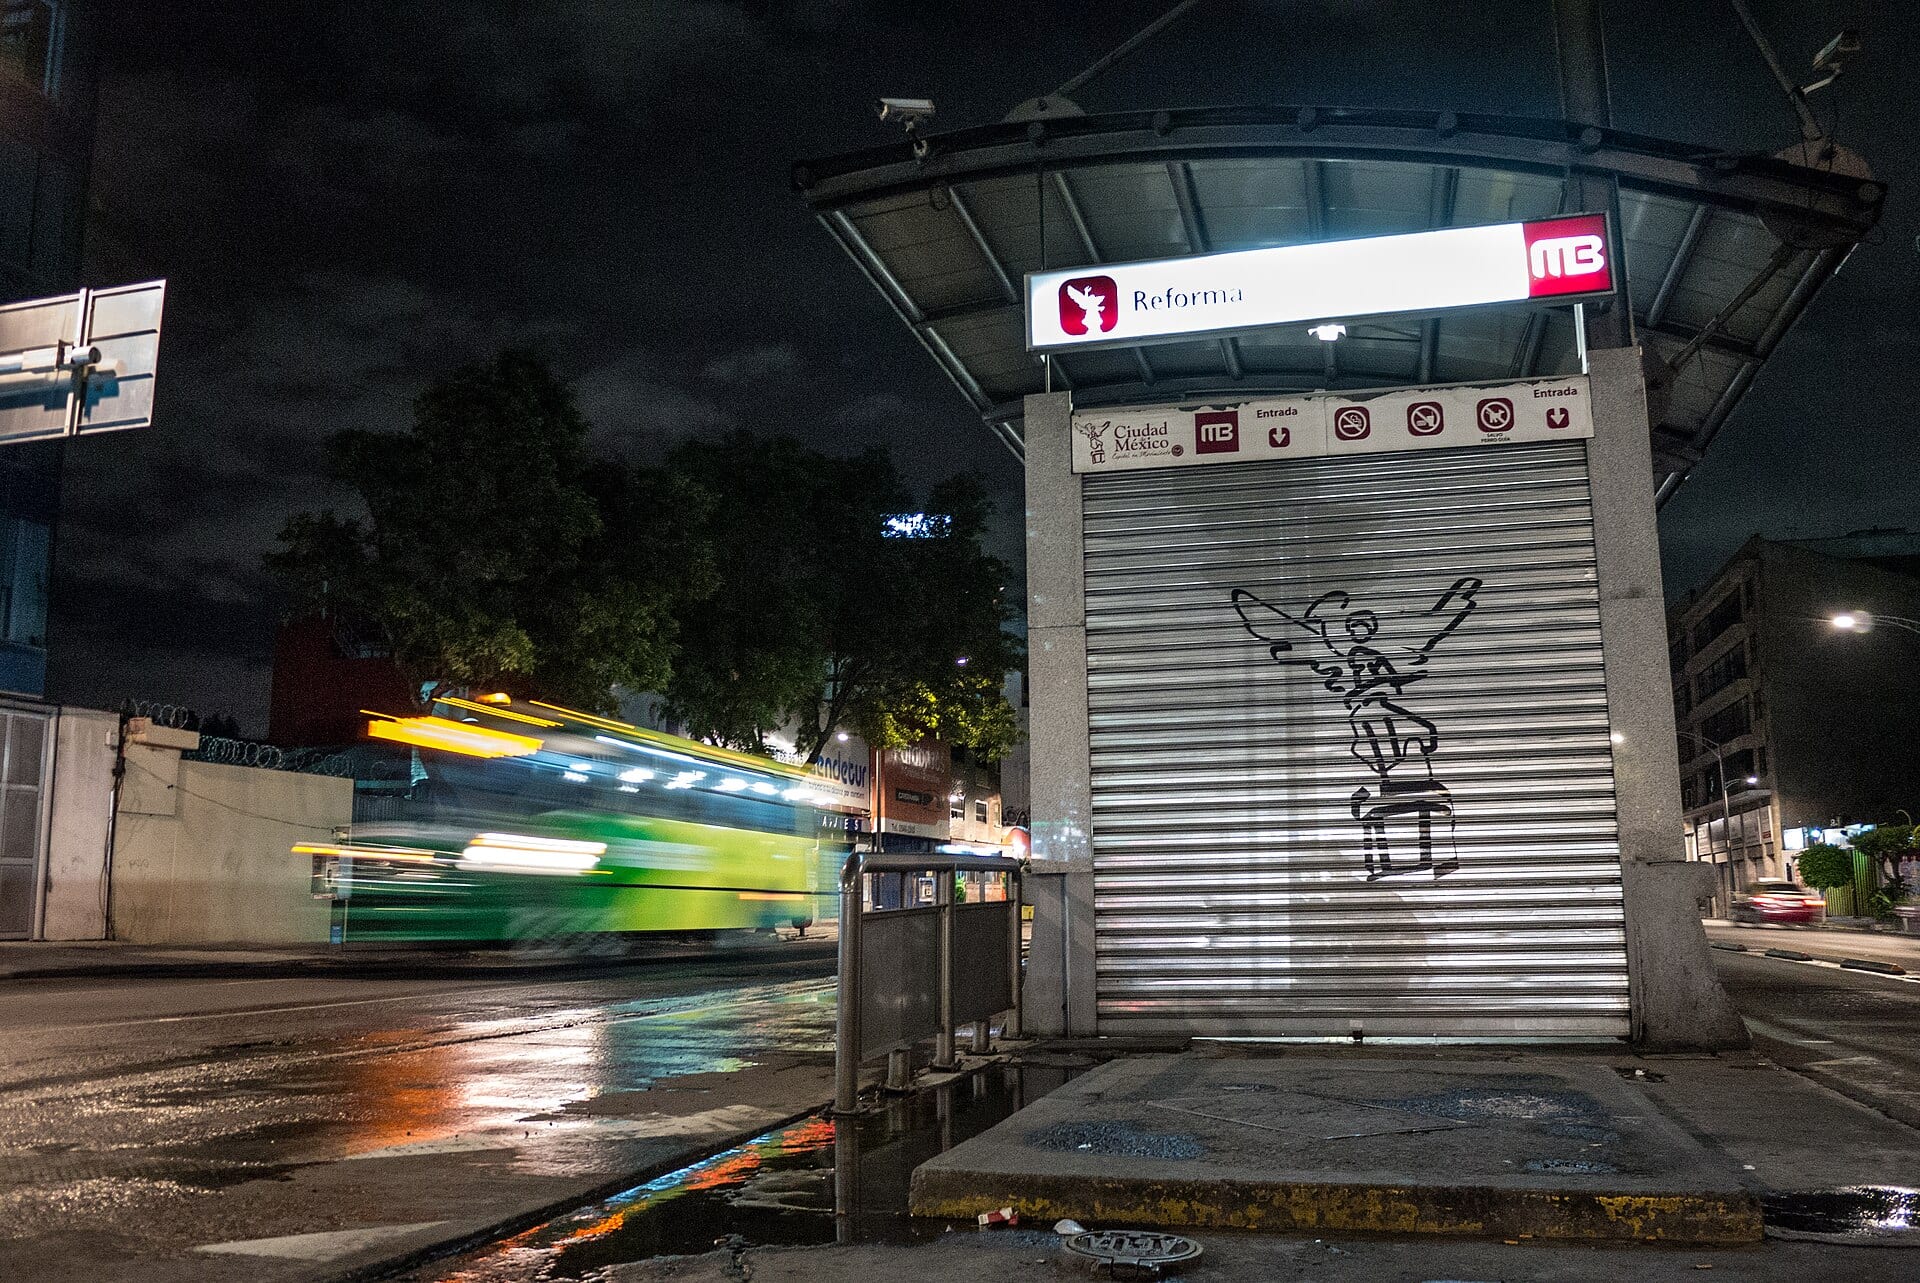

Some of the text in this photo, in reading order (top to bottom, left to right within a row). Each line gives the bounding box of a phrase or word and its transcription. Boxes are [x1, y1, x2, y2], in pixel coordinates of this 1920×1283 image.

[1530, 234, 1605, 279] MB
[1134, 287, 1242, 311] Reforma
[1534, 386, 1578, 398] Entrada
[1256, 407, 1298, 418] Entrada
[1114, 421, 1168, 439] Ciudad
[1201, 423, 1233, 442] MB
[1115, 437, 1169, 452] México
[815, 751, 867, 788] endetur
